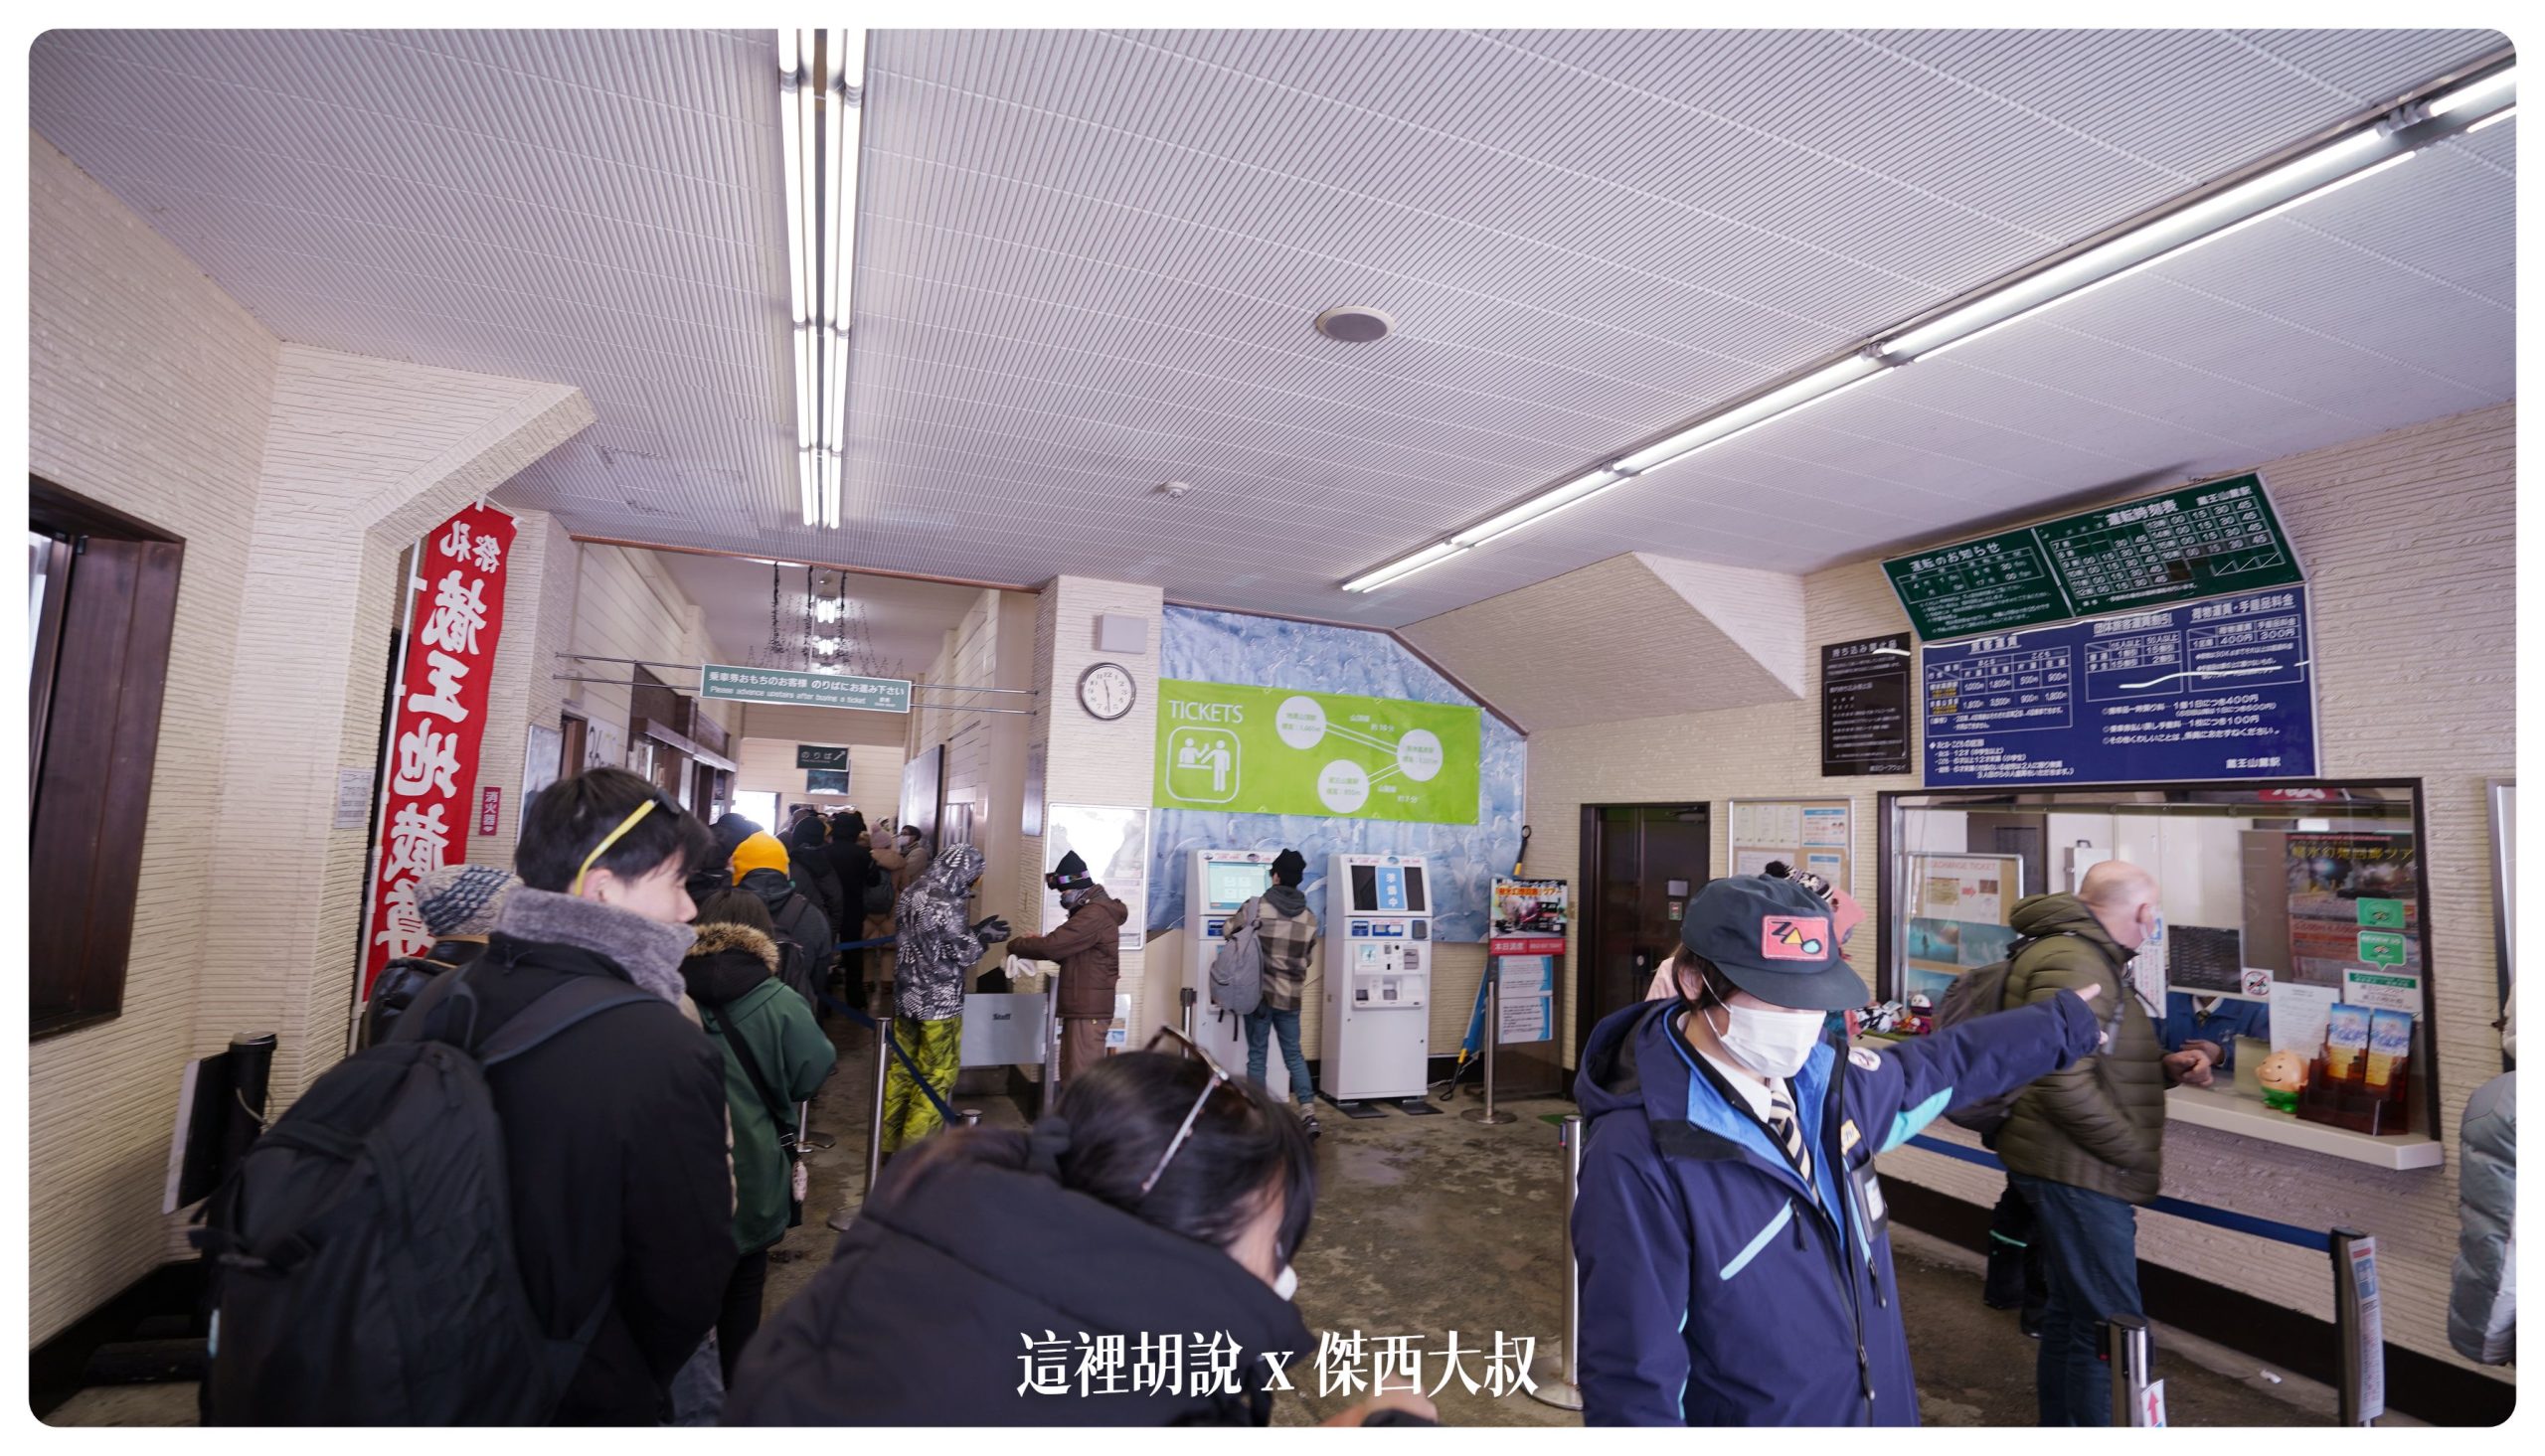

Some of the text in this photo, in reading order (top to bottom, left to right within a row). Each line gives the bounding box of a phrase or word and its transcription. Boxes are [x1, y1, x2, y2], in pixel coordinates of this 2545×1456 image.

[2106, 499, 2179, 527] 運転時刻表
[1910, 542, 2000, 572] 運転のお知らせ
[2220, 633, 2254, 644] 400円
[2260, 628, 2295, 640] 300円
[709, 671, 906, 697] 乗車券おもちのお客様 のりばにお進み下さい
[709, 685, 734, 695] Please
[847, 695, 866, 705] ticket
[1168, 700, 1244, 724] TICKETS
[1771, 920, 1822, 955] ZAO
